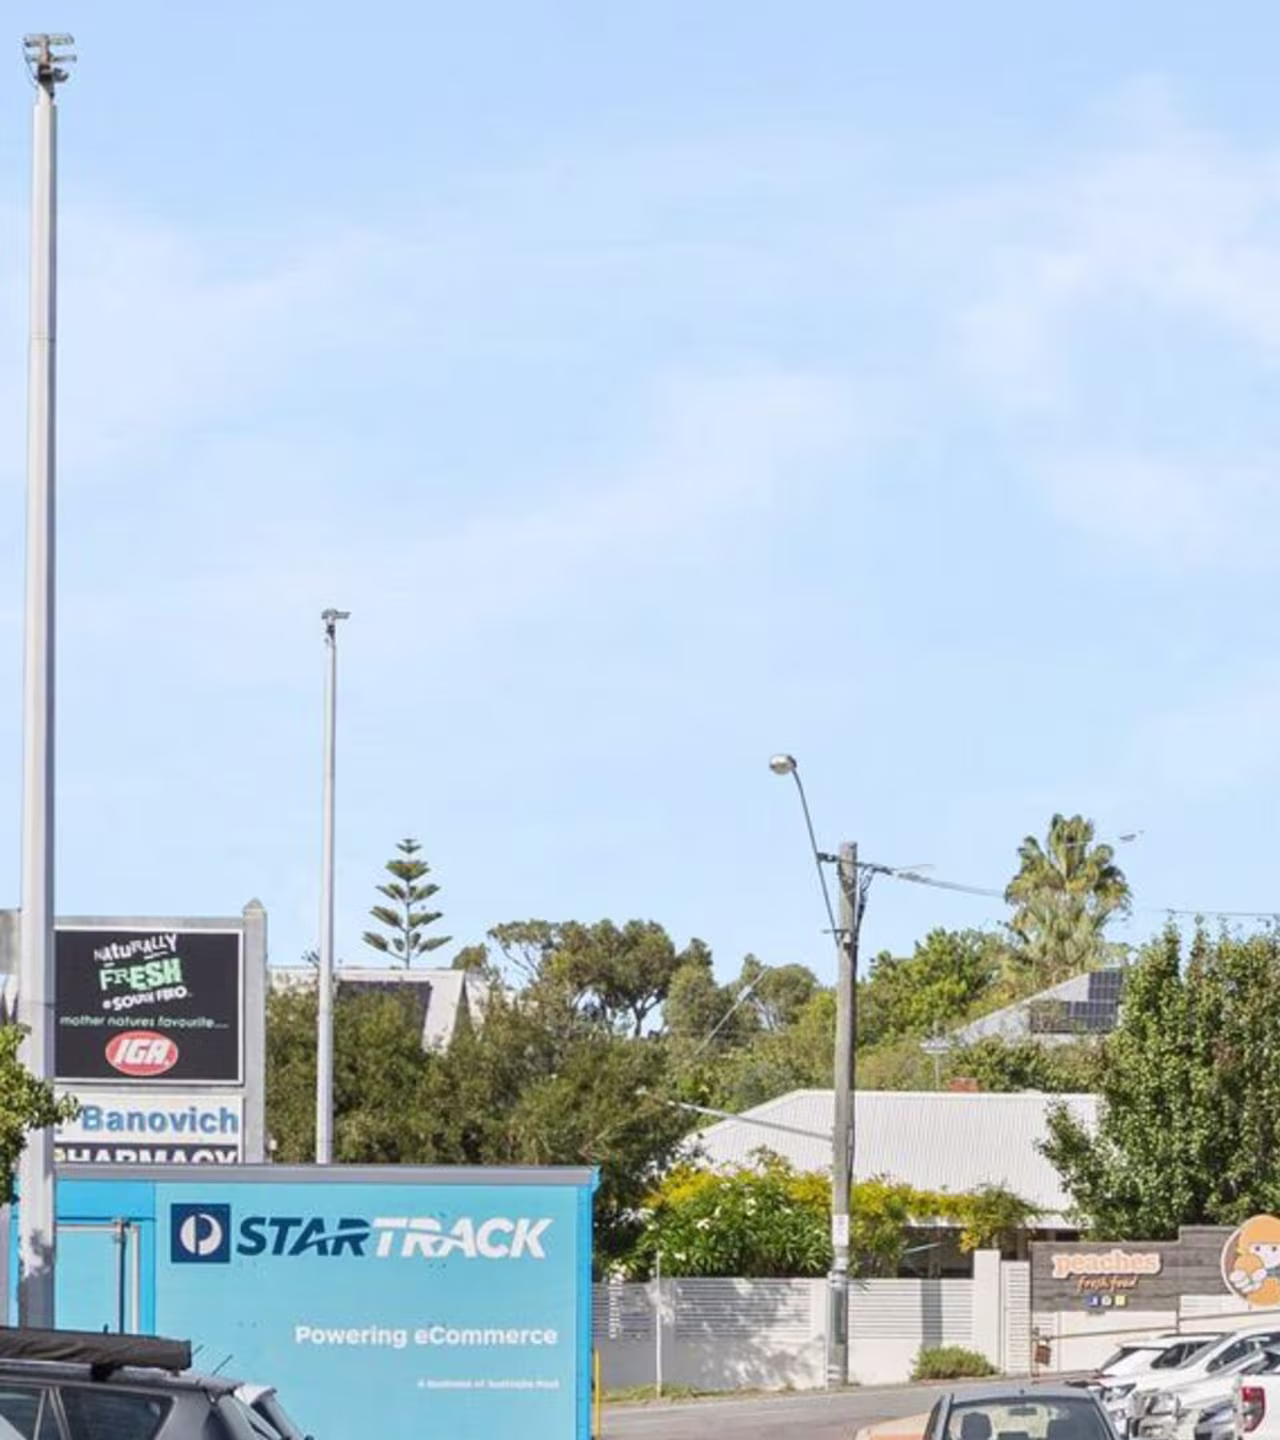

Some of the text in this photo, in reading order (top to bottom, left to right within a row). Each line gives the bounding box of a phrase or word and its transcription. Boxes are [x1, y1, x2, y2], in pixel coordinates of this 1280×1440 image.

[99, 957, 184, 991] FRESH
[59, 1015, 105, 1027] mother
[108, 1015, 154, 1028] natures
[114, 1038, 171, 1066] IGA
[81, 1105, 239, 1134] Banovich
[1052, 1249, 1161, 1279] peaches
[294, 1325, 558, 1349] Powering eCommerce
